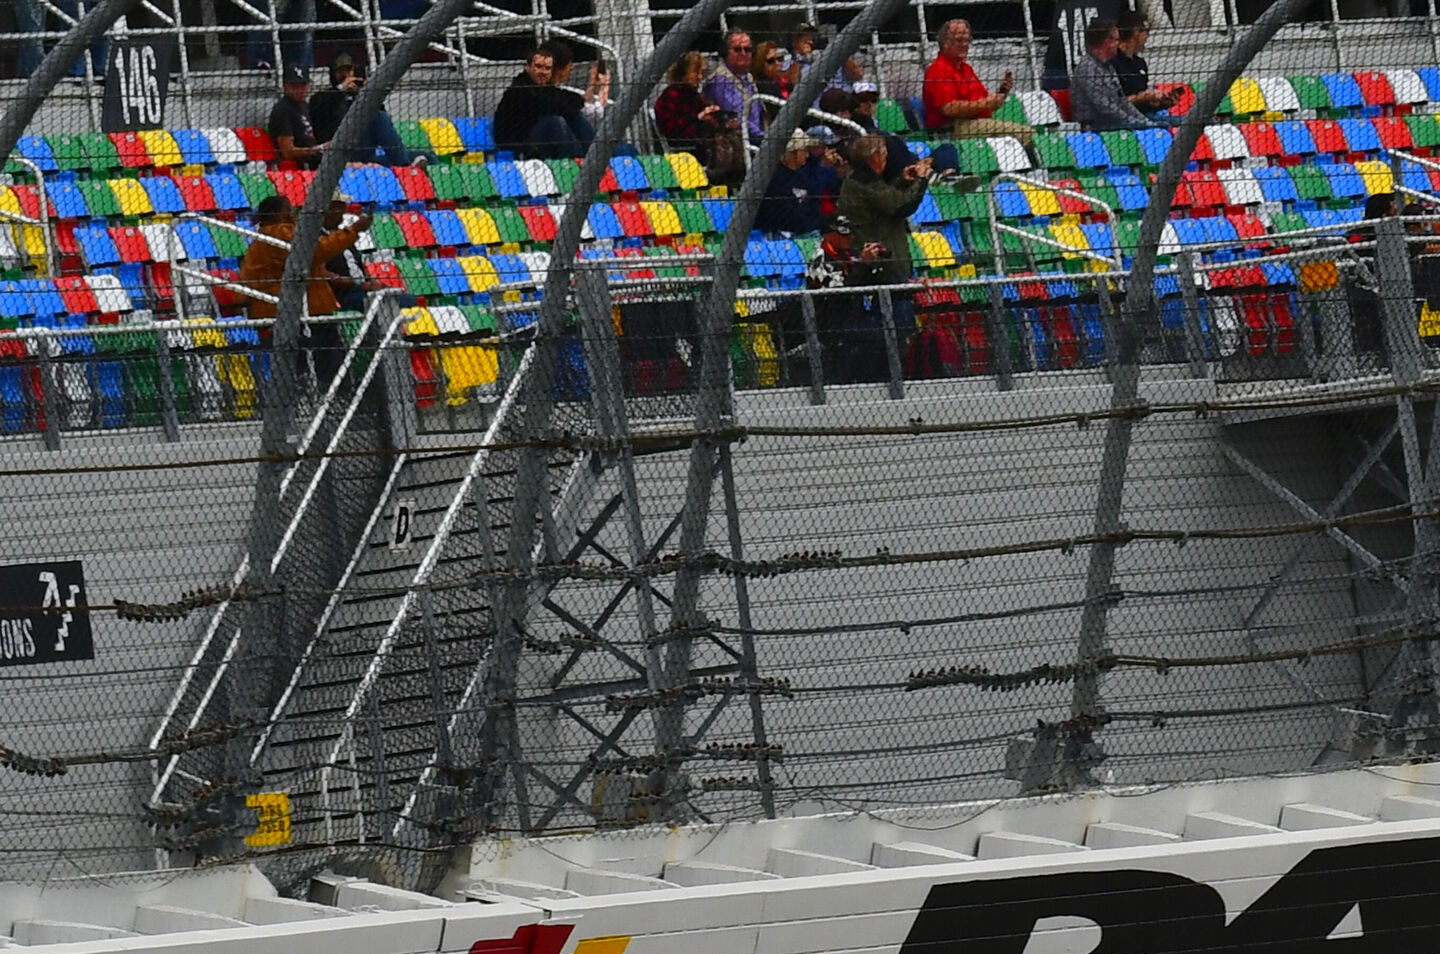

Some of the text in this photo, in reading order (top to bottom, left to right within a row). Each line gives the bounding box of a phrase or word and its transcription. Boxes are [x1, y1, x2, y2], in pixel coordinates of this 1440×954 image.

[115, 45, 161, 125] 146
[395, 506, 409, 544] D
[0, 618, 36, 659] ONS
